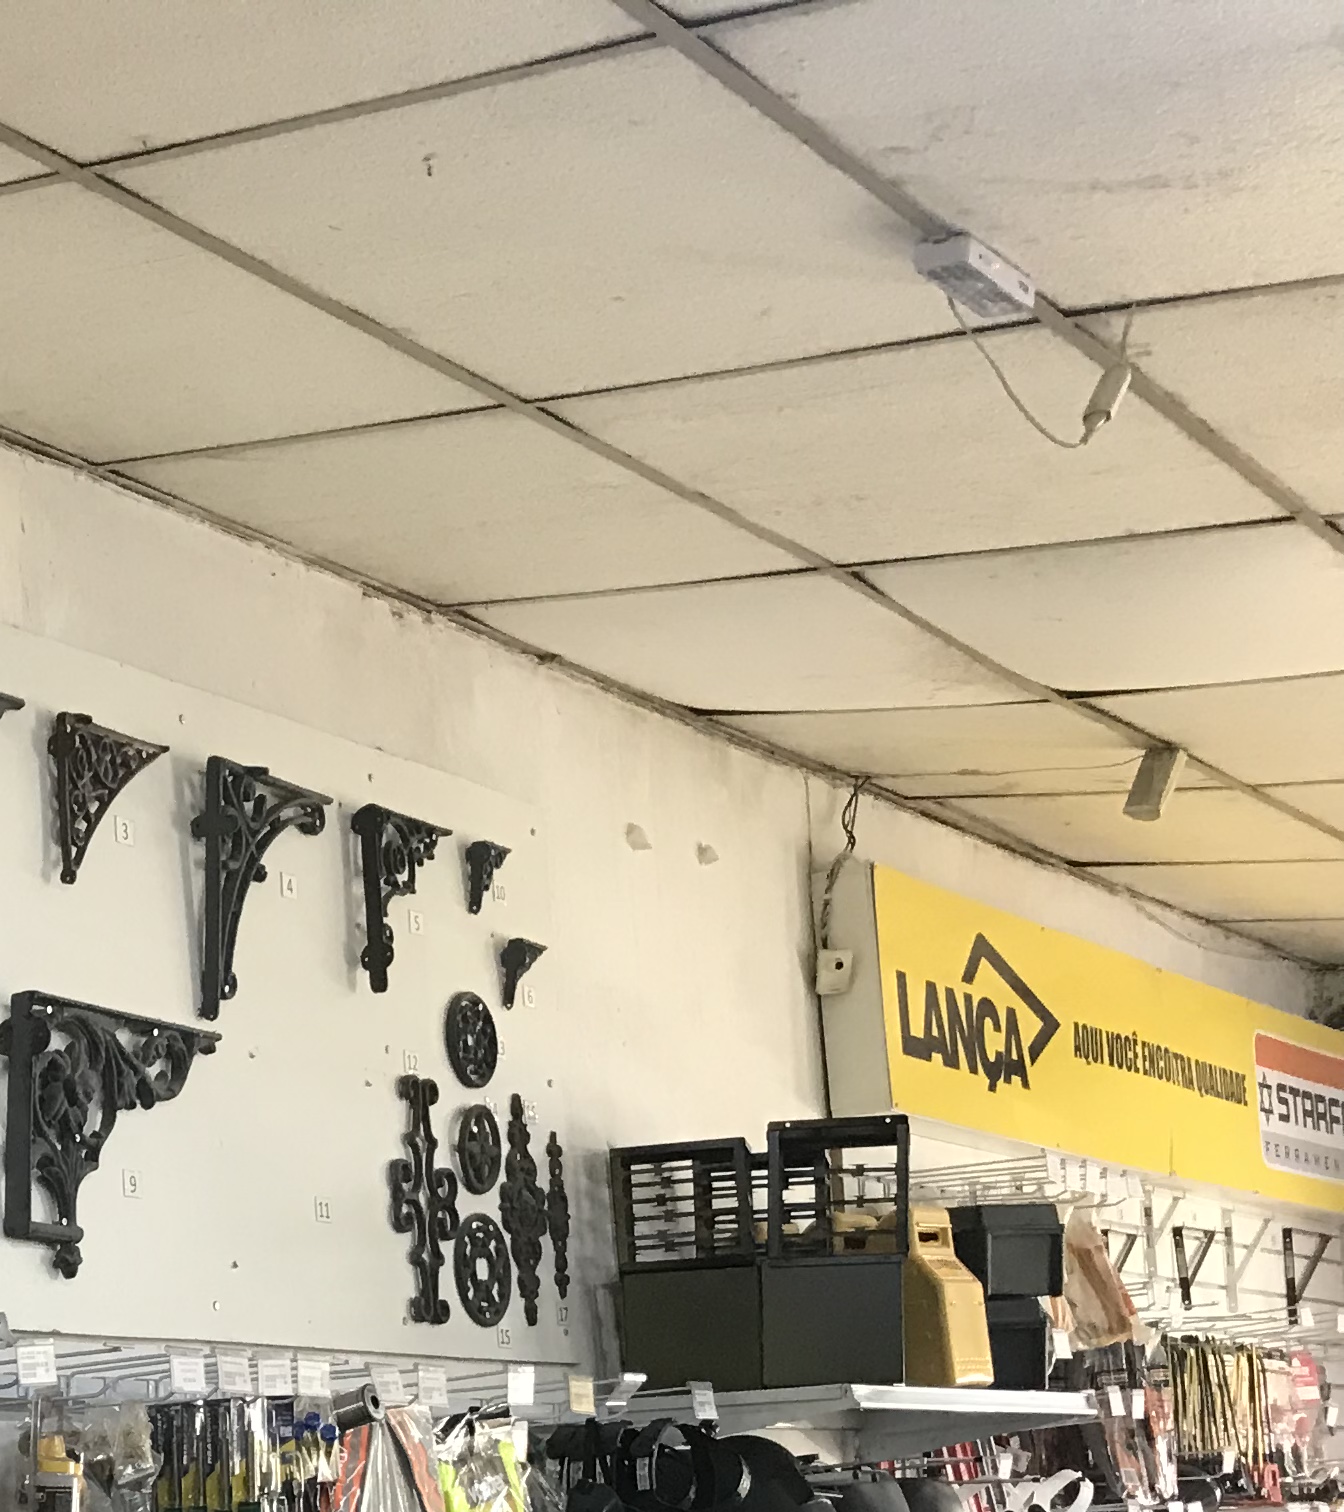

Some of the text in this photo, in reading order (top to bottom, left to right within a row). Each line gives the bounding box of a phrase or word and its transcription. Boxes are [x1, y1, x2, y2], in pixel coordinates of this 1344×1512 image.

[121, 822, 129, 841] 3
[286, 878, 293, 894] 4
[414, 915, 420, 932] 5
[895, 971, 1031, 1092] LANÇA
[1073, 1021, 1104, 1065] AQUI
[1105, 1031, 1139, 1074] VOCÊ
[1141, 1040, 1195, 1091] ENCONTRA
[1276, 1082, 1344, 1135] STARF
[129, 1175, 137, 1194] 9
[318, 1202, 330, 1219] 11
